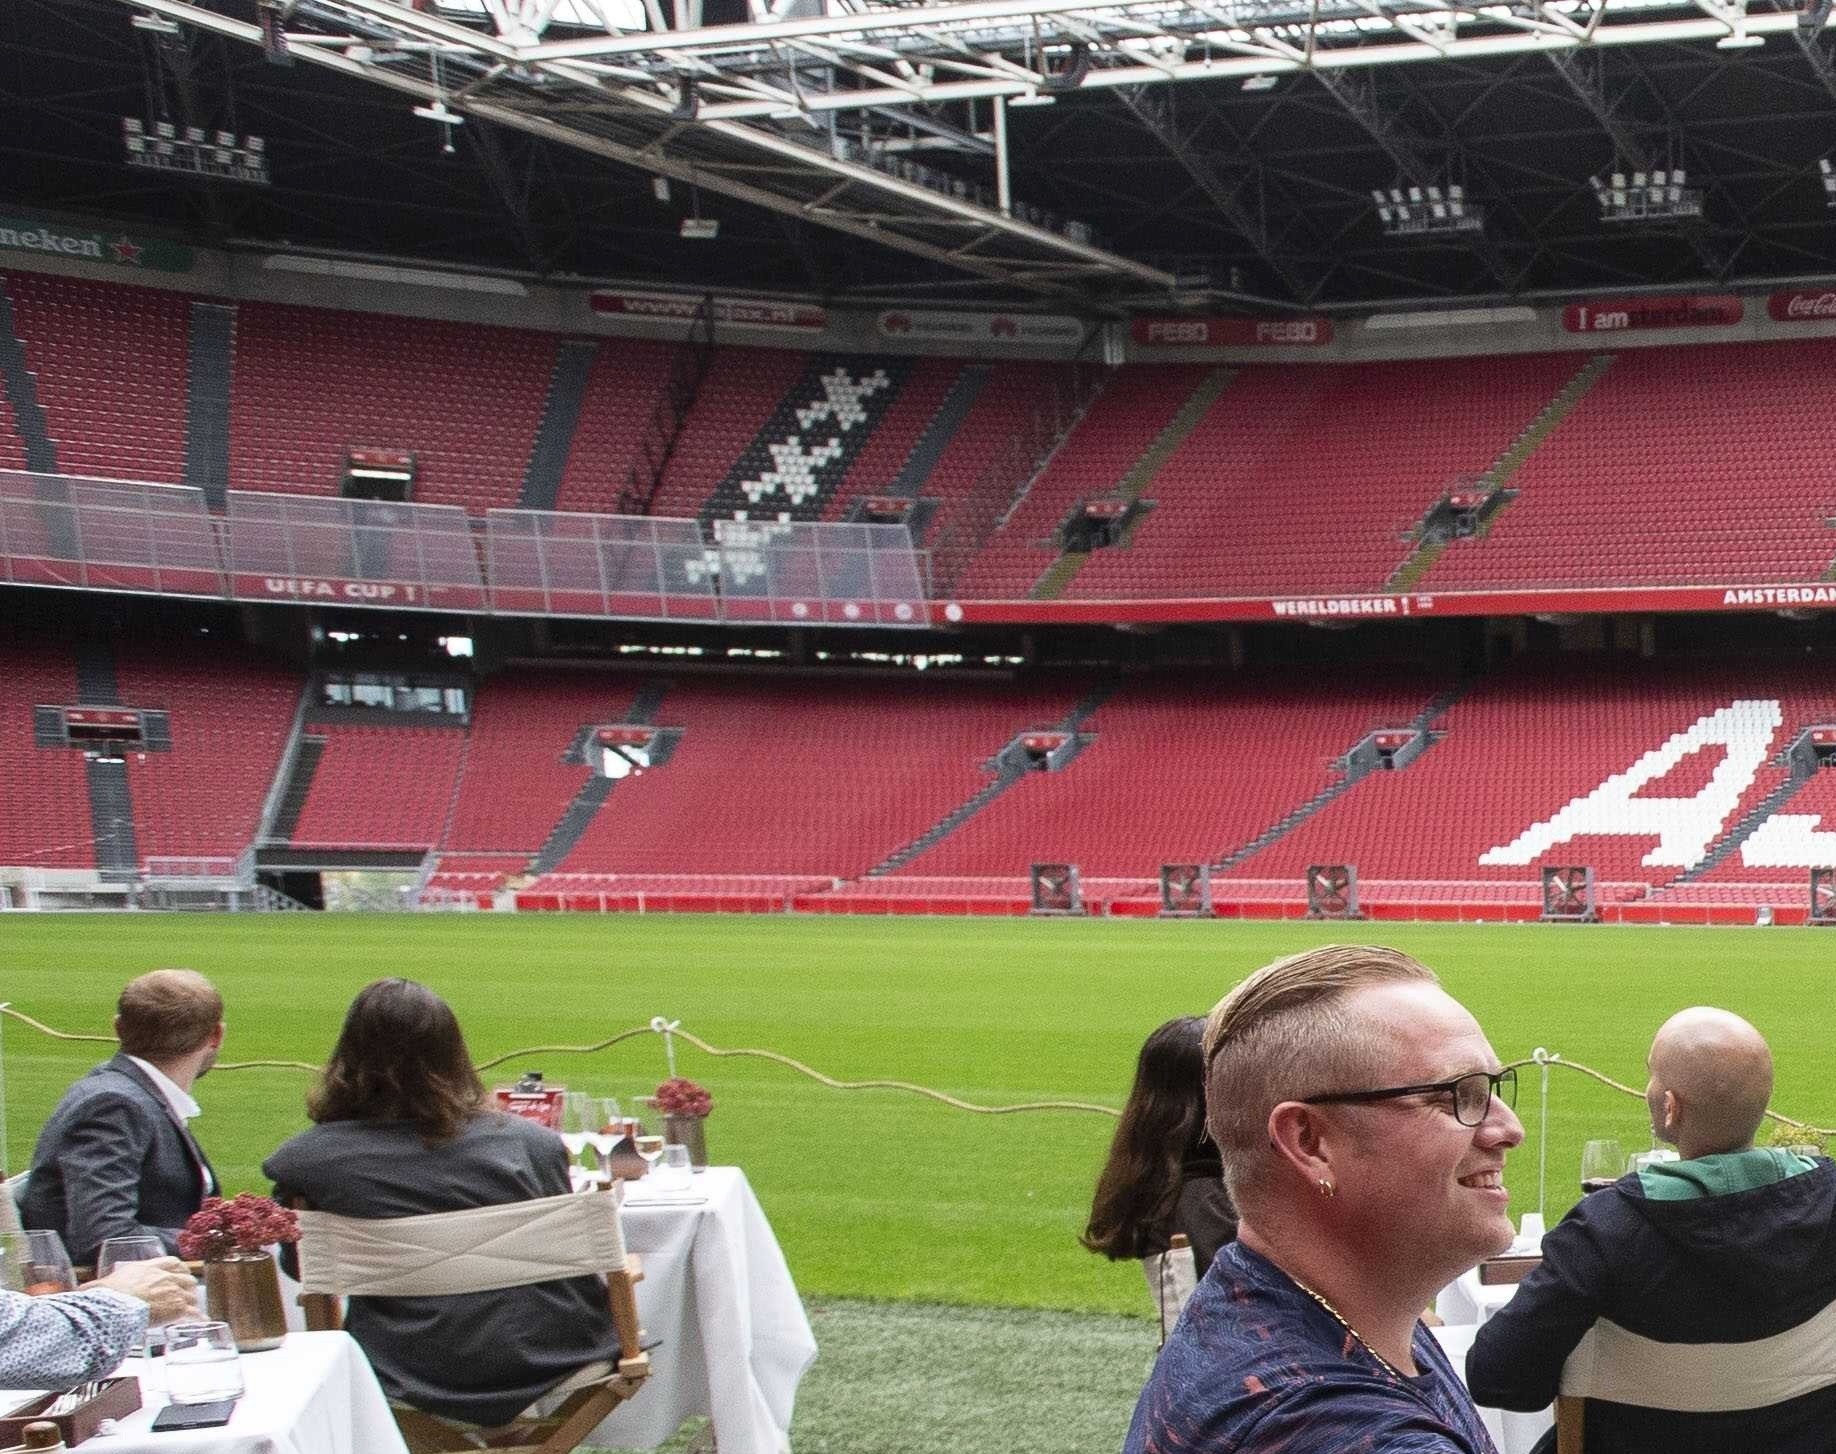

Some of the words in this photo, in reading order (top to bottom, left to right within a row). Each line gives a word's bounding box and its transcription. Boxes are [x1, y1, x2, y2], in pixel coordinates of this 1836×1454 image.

[0, 227, 102, 257] neken
[1579, 307, 1587, 330] I
[1149, 322, 1209, 341] FEBO
[1256, 322, 1317, 341] FEBO
[265, 578, 335, 596] UEFA
[344, 584, 396, 599] CUP
[1272, 599, 1397, 616] WERELDBEKER
